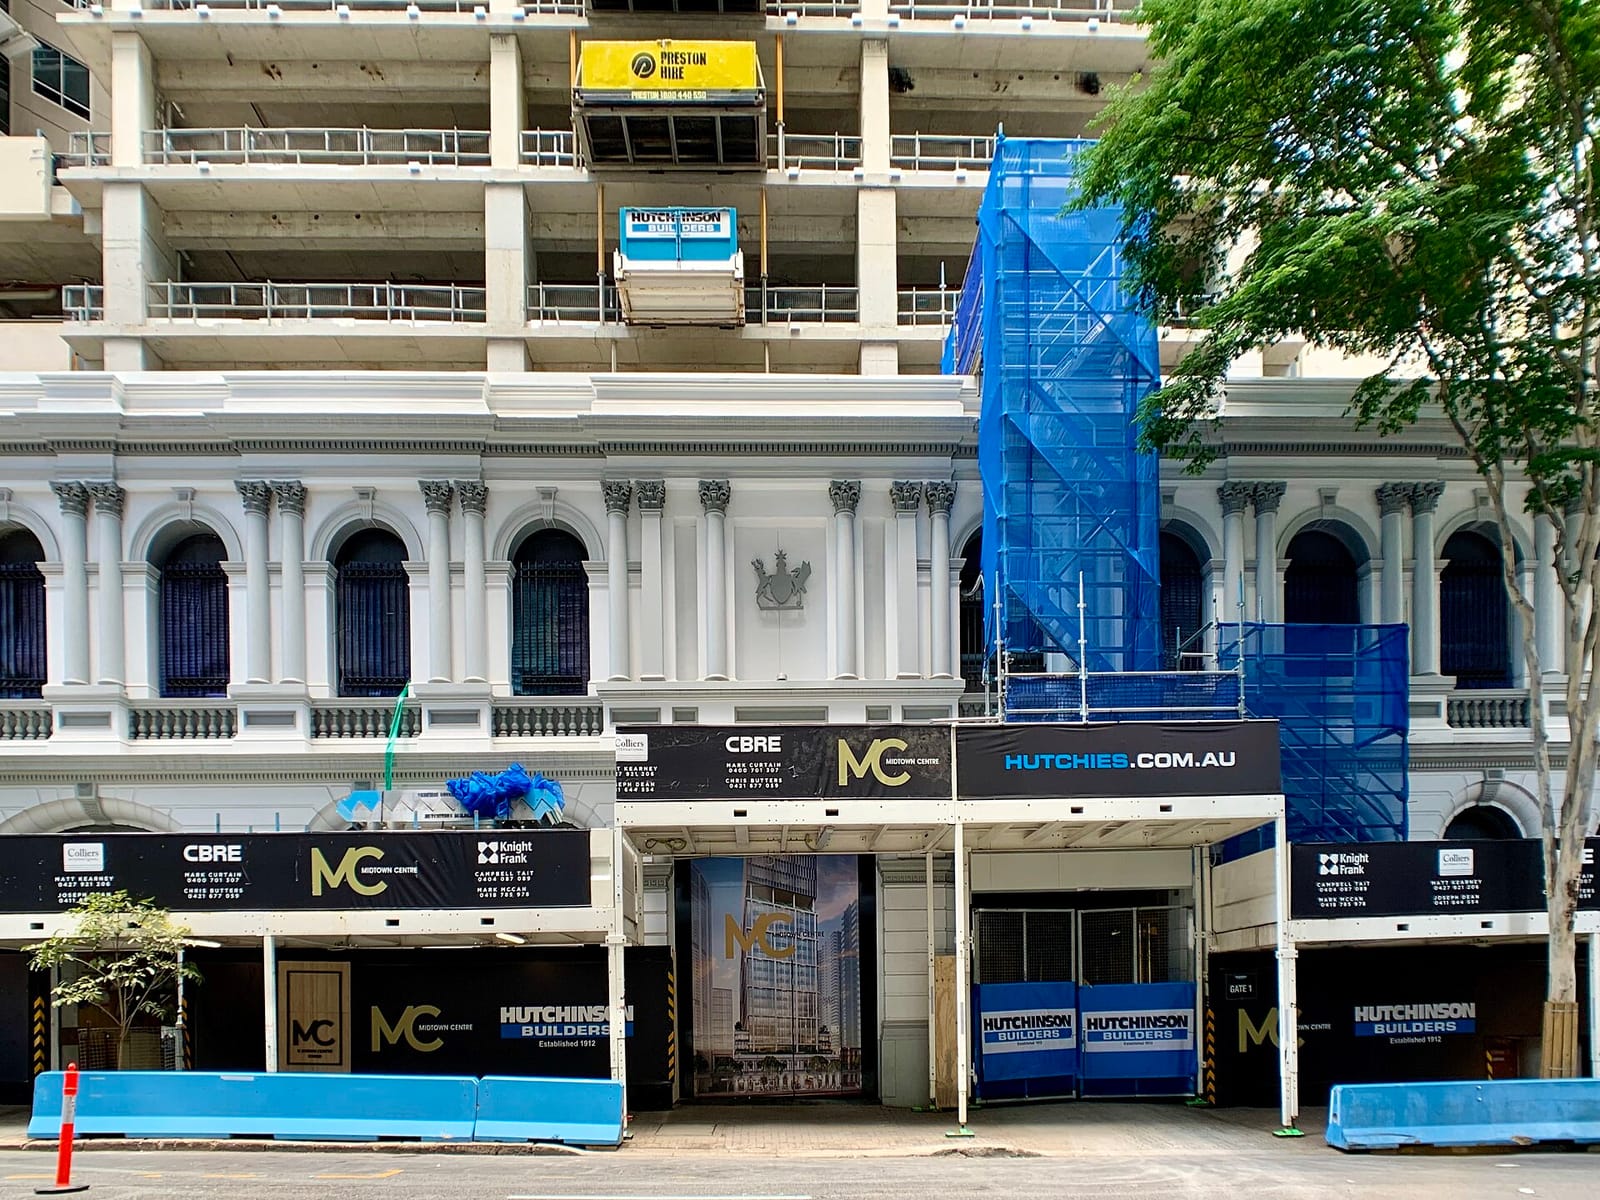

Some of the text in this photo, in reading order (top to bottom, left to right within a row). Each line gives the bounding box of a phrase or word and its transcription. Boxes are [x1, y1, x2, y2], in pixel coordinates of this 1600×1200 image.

[660, 51, 707, 65] PRESTON
[660, 66, 684, 79] HIRE
[632, 212, 721, 223] HUTCHINSON
[648, 224, 714, 232] BUILDERS
[725, 736, 782, 753] CBRE
[838, 738, 912, 787] MC
[1004, 751, 1236, 770] HUTCHIES.COM.AU
[67, 848, 99, 858] Colliers
[183, 844, 243, 862] CBRE
[500, 841, 533, 854] Knight
[500, 853, 528, 864] Frank
[1340, 853, 1370, 866] Knight
[311, 846, 388, 896] MC
[1340, 864, 1365, 875] Frank
[724, 911, 796, 960] MC
[1229, 984, 1253, 993] GATE 1
[500, 1005, 634, 1023] HUTCHINSN
[1355, 1002, 1476, 1022] HUTCHINSON
[371, 1004, 444, 1052] MC
[450, 1023, 474, 1031] CENTRE
[983, 1014, 1072, 1031] HUTCHINSON
[1086, 1014, 1189, 1030] HUTCHINSON
[1374, 1022, 1457, 1034] BUILDERS
[292, 1019, 336, 1046] MC
[998, 1029, 1060, 1041] BUILDERS
[1103, 1030, 1173, 1040] BUILDERS
[538, 1039, 597, 1048] Established 1912
[1390, 1035, 1442, 1044] Established 1912
